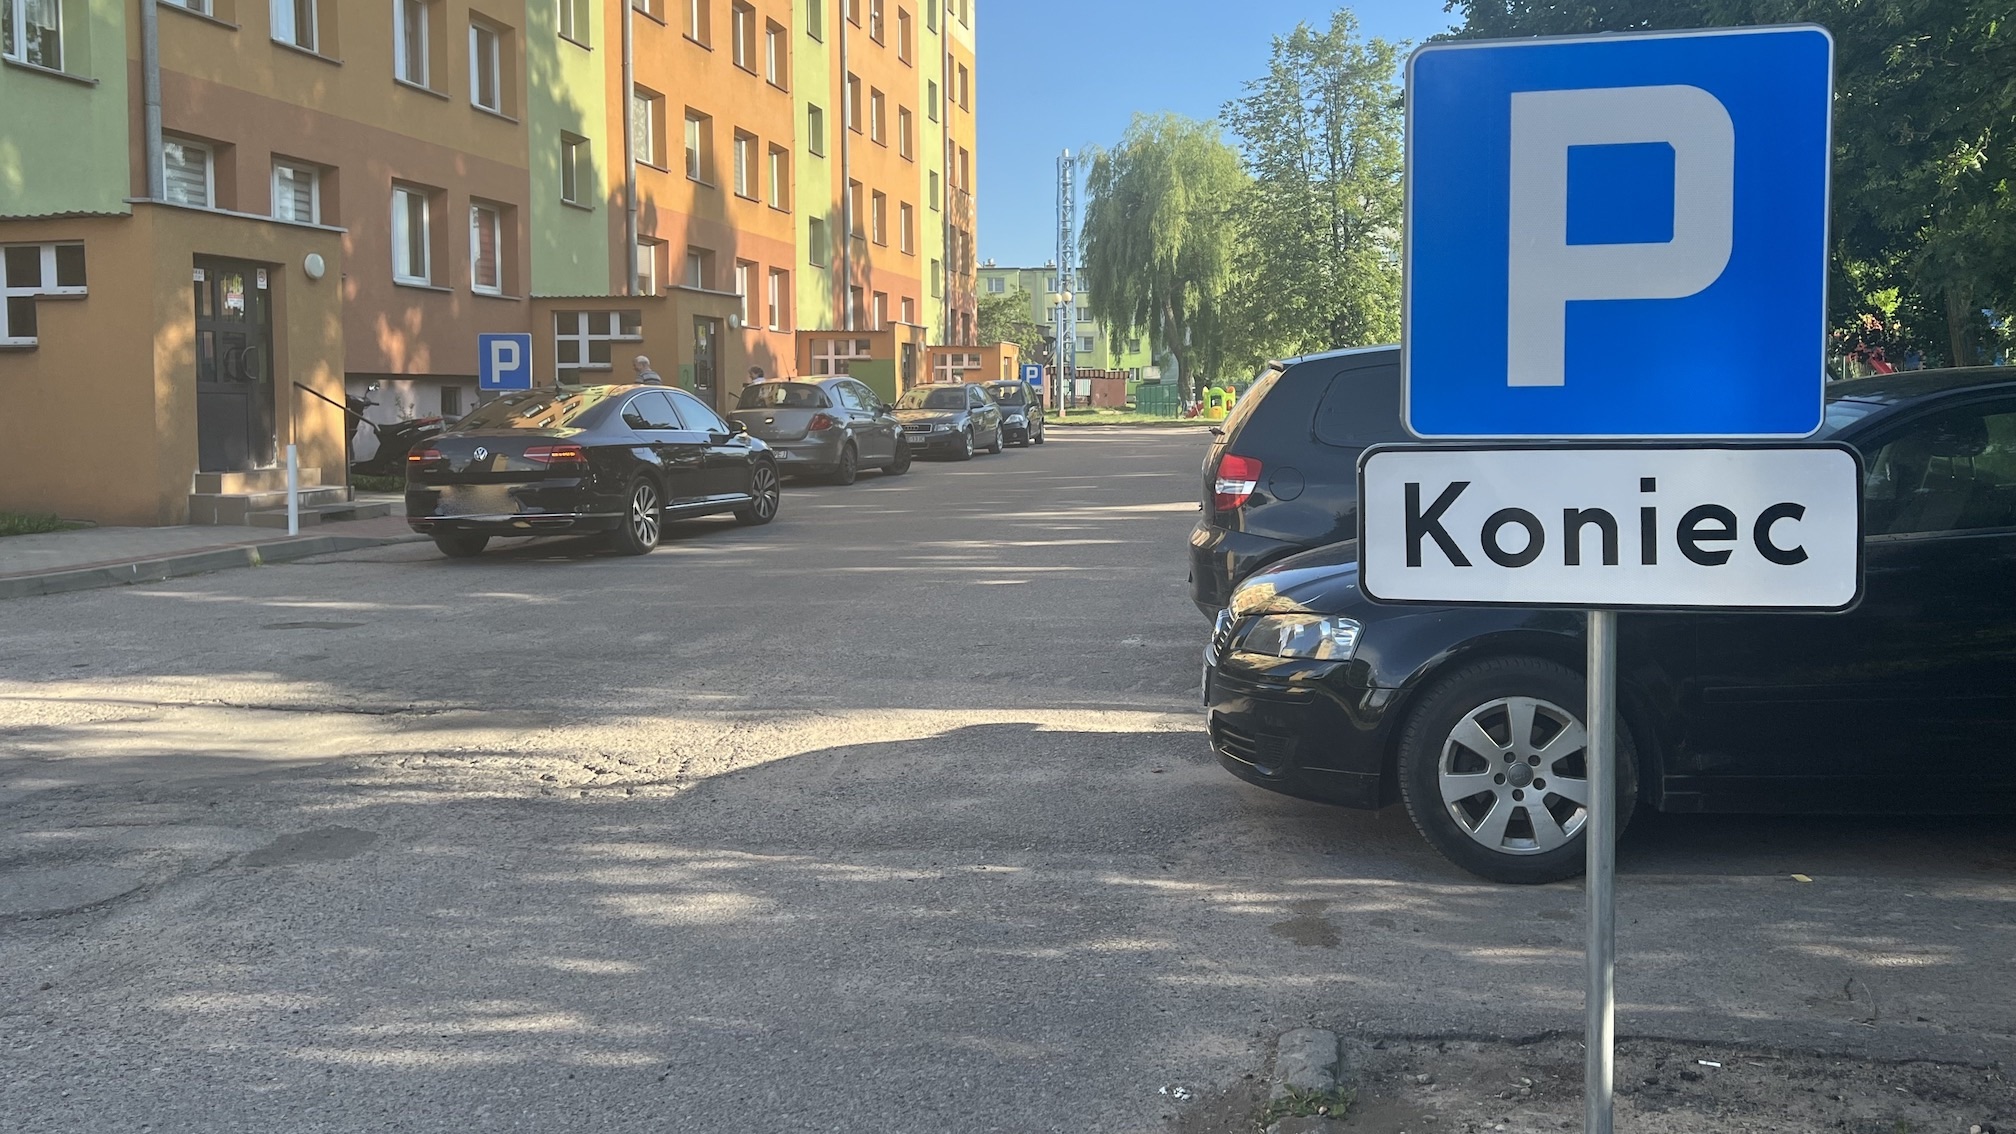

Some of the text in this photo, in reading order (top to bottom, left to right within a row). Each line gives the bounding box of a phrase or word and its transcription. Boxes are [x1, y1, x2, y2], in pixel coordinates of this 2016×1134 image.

[1507, 84, 1735, 388] P
[491, 340, 520, 383] P
[1026, 366, 1039, 383] P
[1404, 477, 1809, 568] Koniec
